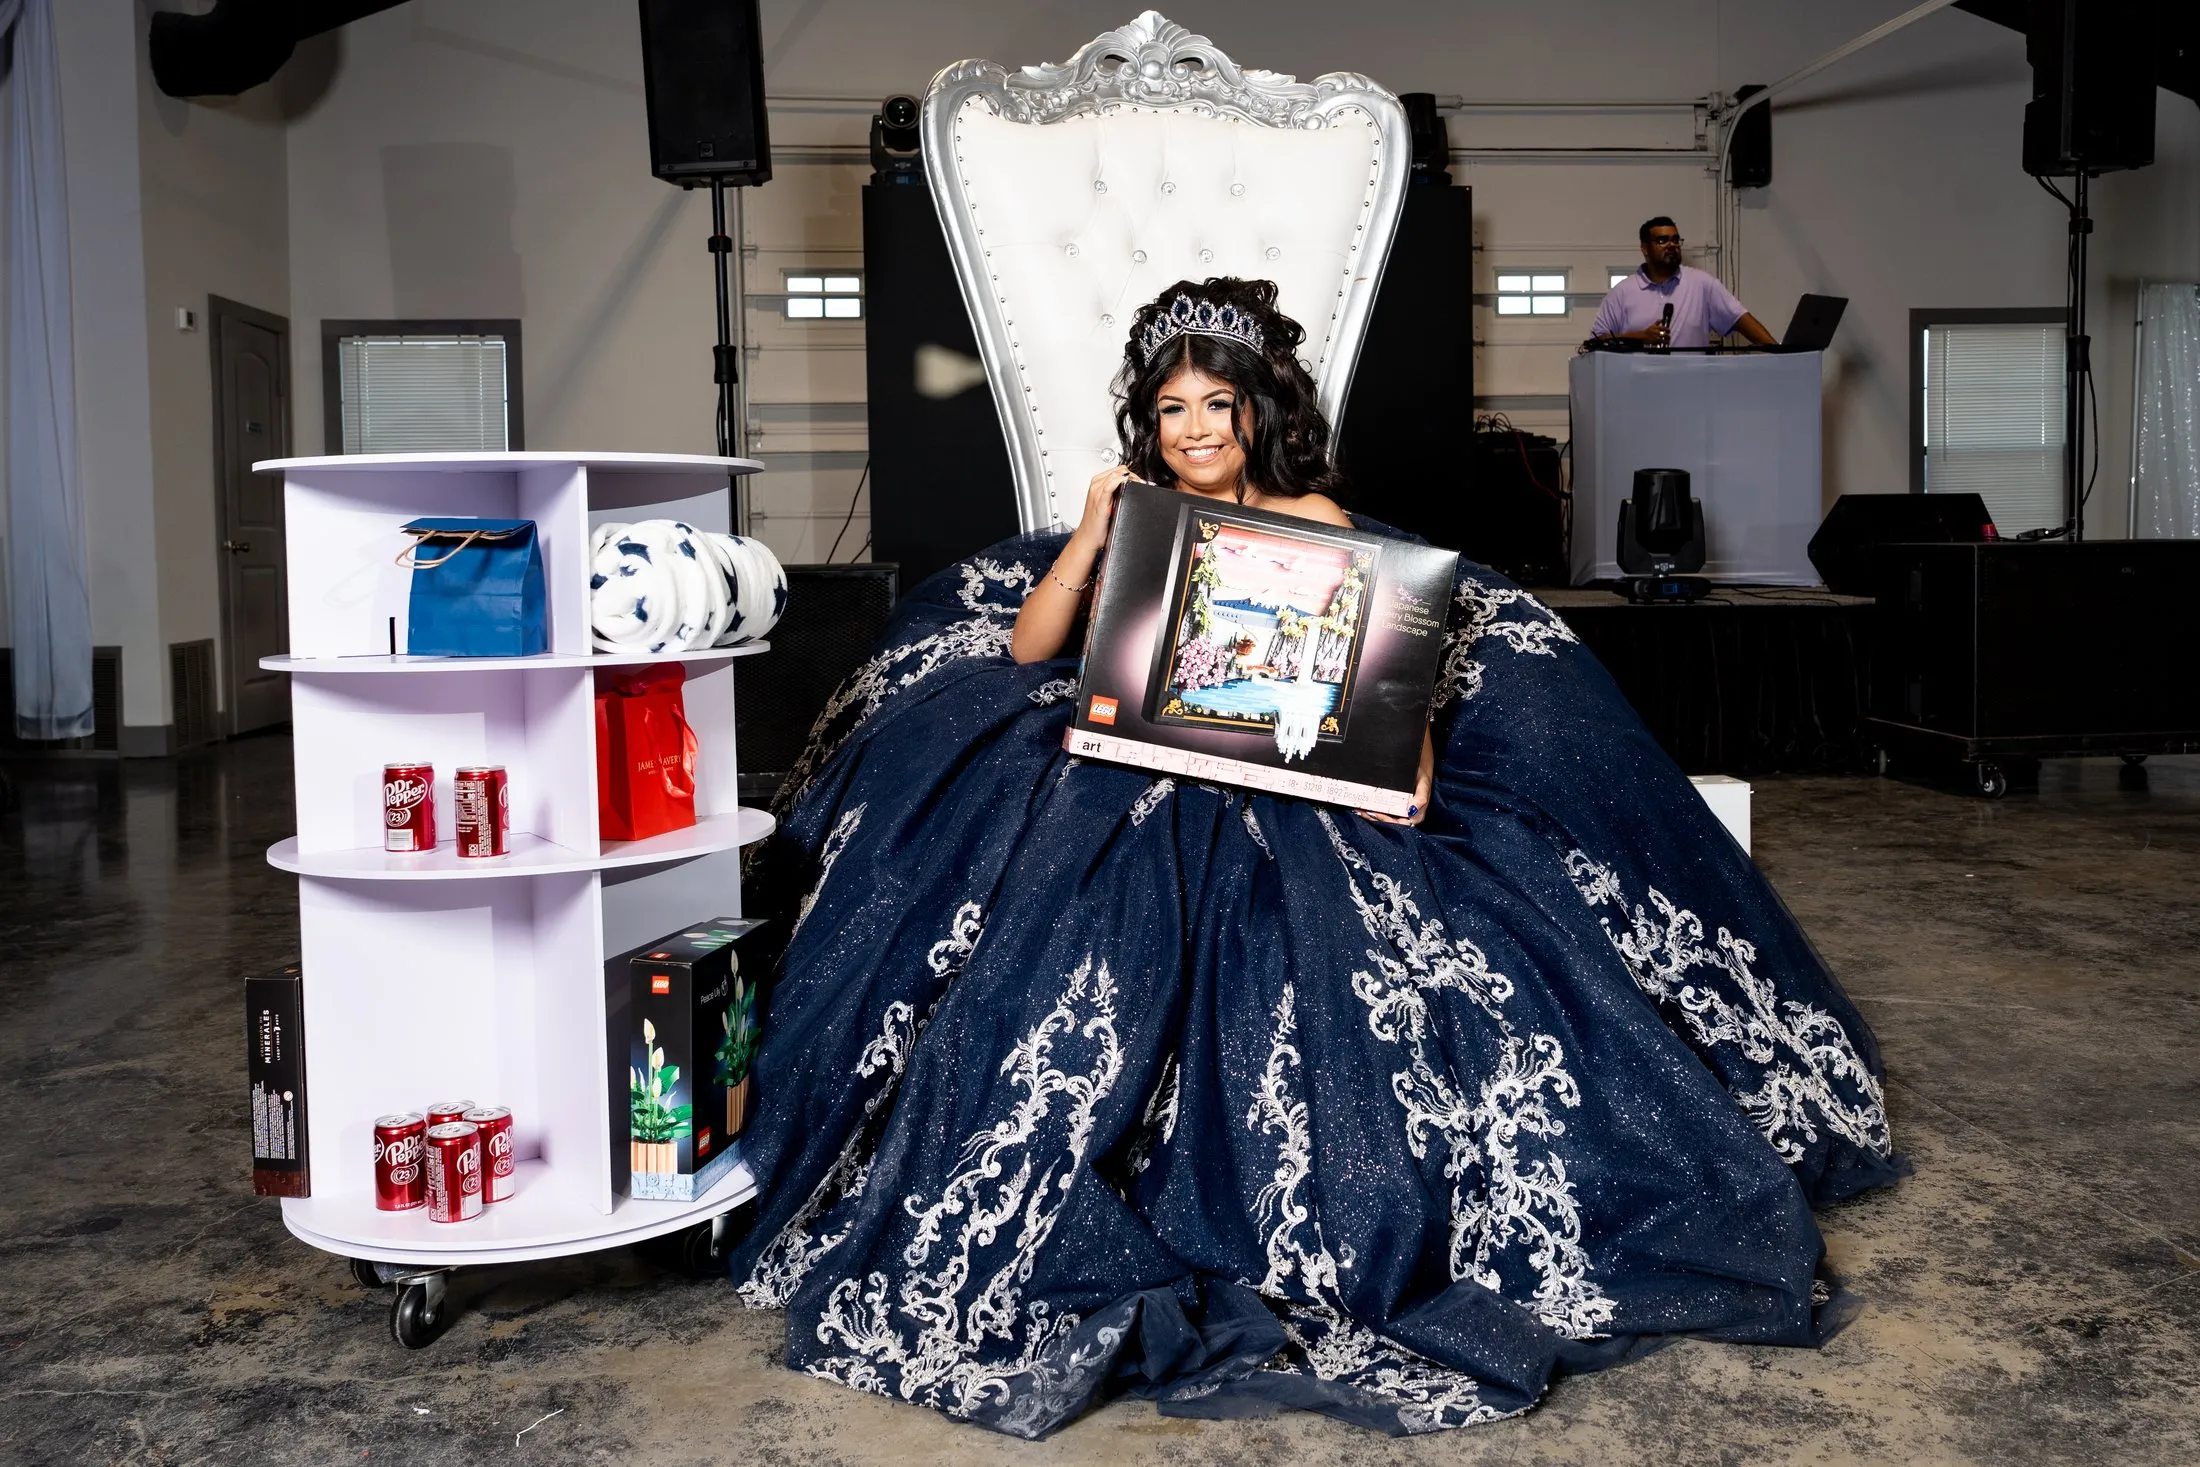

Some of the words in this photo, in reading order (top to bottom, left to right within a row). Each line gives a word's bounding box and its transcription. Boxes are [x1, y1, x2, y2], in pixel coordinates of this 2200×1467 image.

[1404, 613, 1440, 628] Blossom
[1382, 620, 1429, 637] Landscape
[1092, 703, 1116, 717] LEGO
[1082, 740, 1102, 753] art
[638, 761, 654, 772] JAME
[394, 779, 413, 794] Dr
[384, 783, 425, 807] Pepper
[391, 812, 401, 822] 23
[262, 1009, 271, 1064] MINERALES
[403, 1135, 420, 1151] Dr
[399, 1169, 409, 1180] 23
